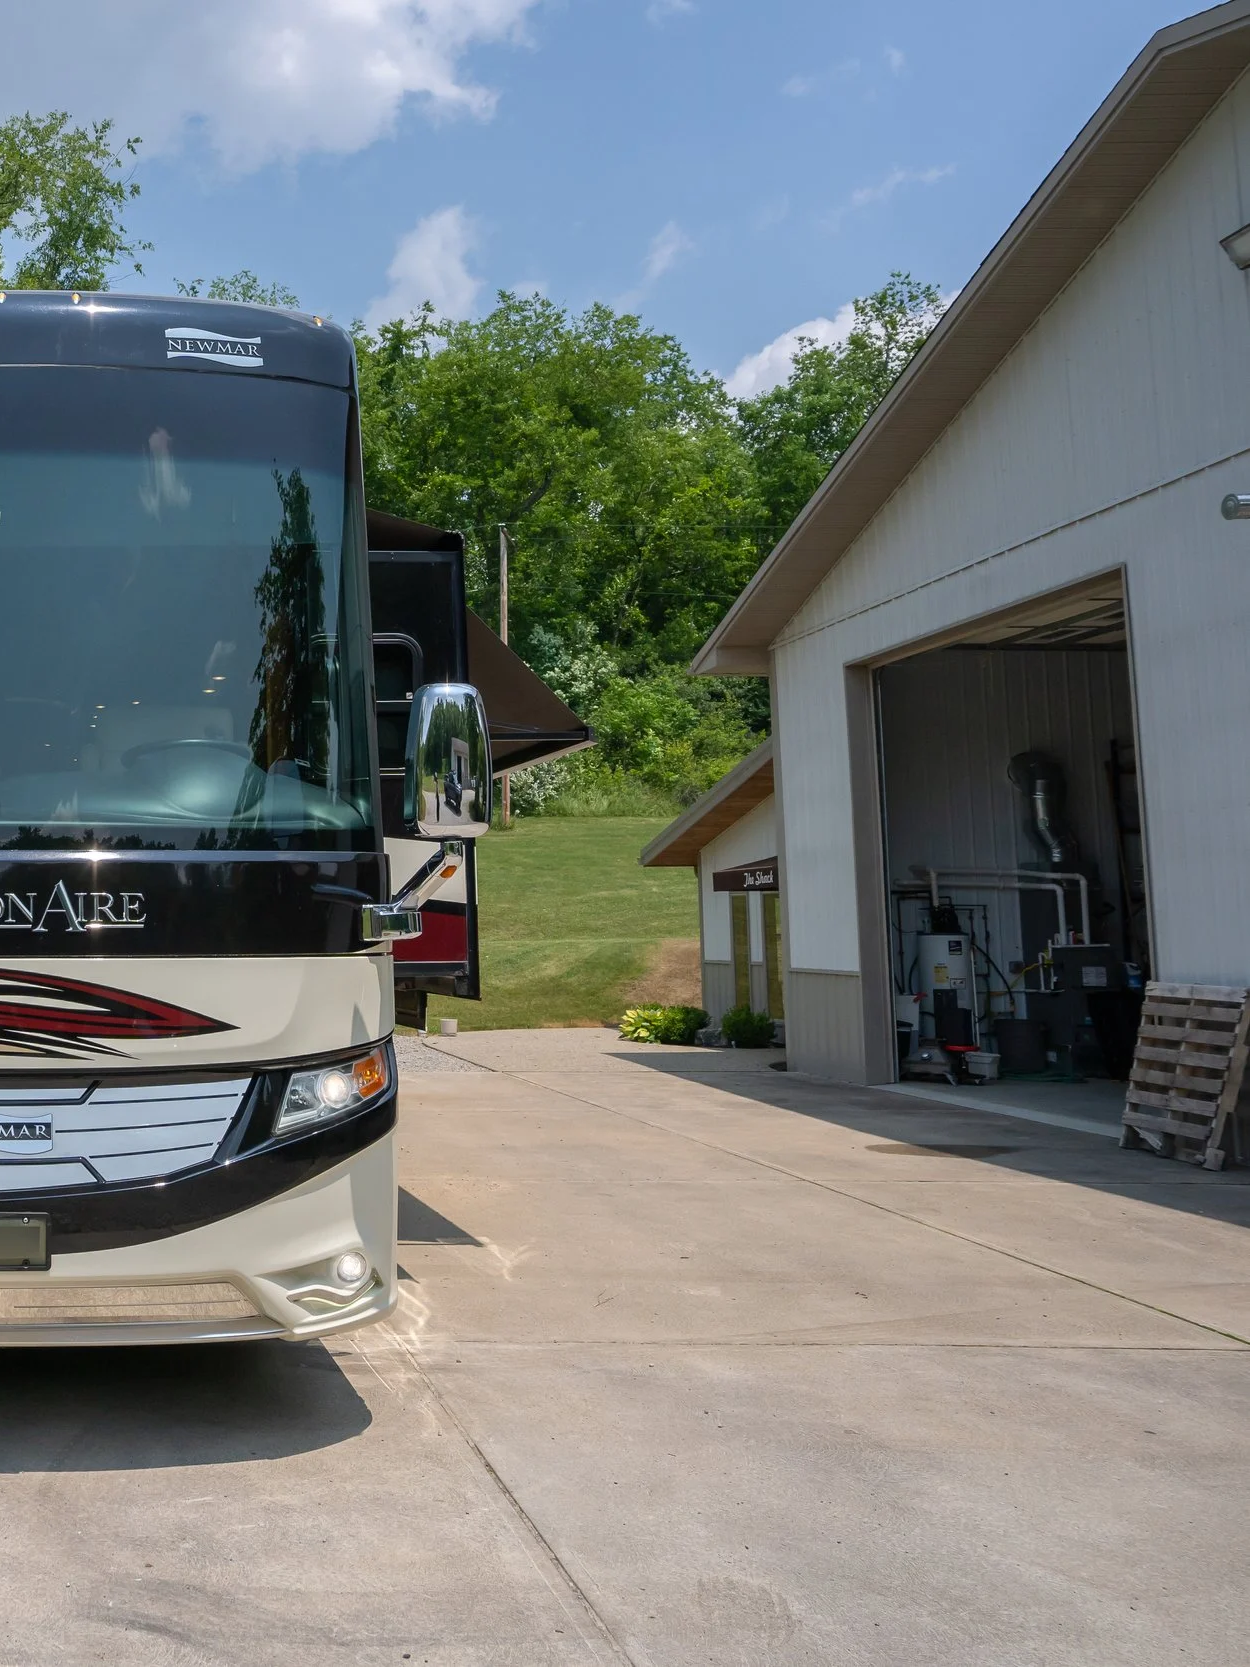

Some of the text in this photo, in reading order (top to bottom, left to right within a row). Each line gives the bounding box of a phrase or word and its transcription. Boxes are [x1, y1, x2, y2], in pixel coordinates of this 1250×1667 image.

[168, 339, 261, 357] NEWMAR
[743, 870, 774, 888] The Shack
